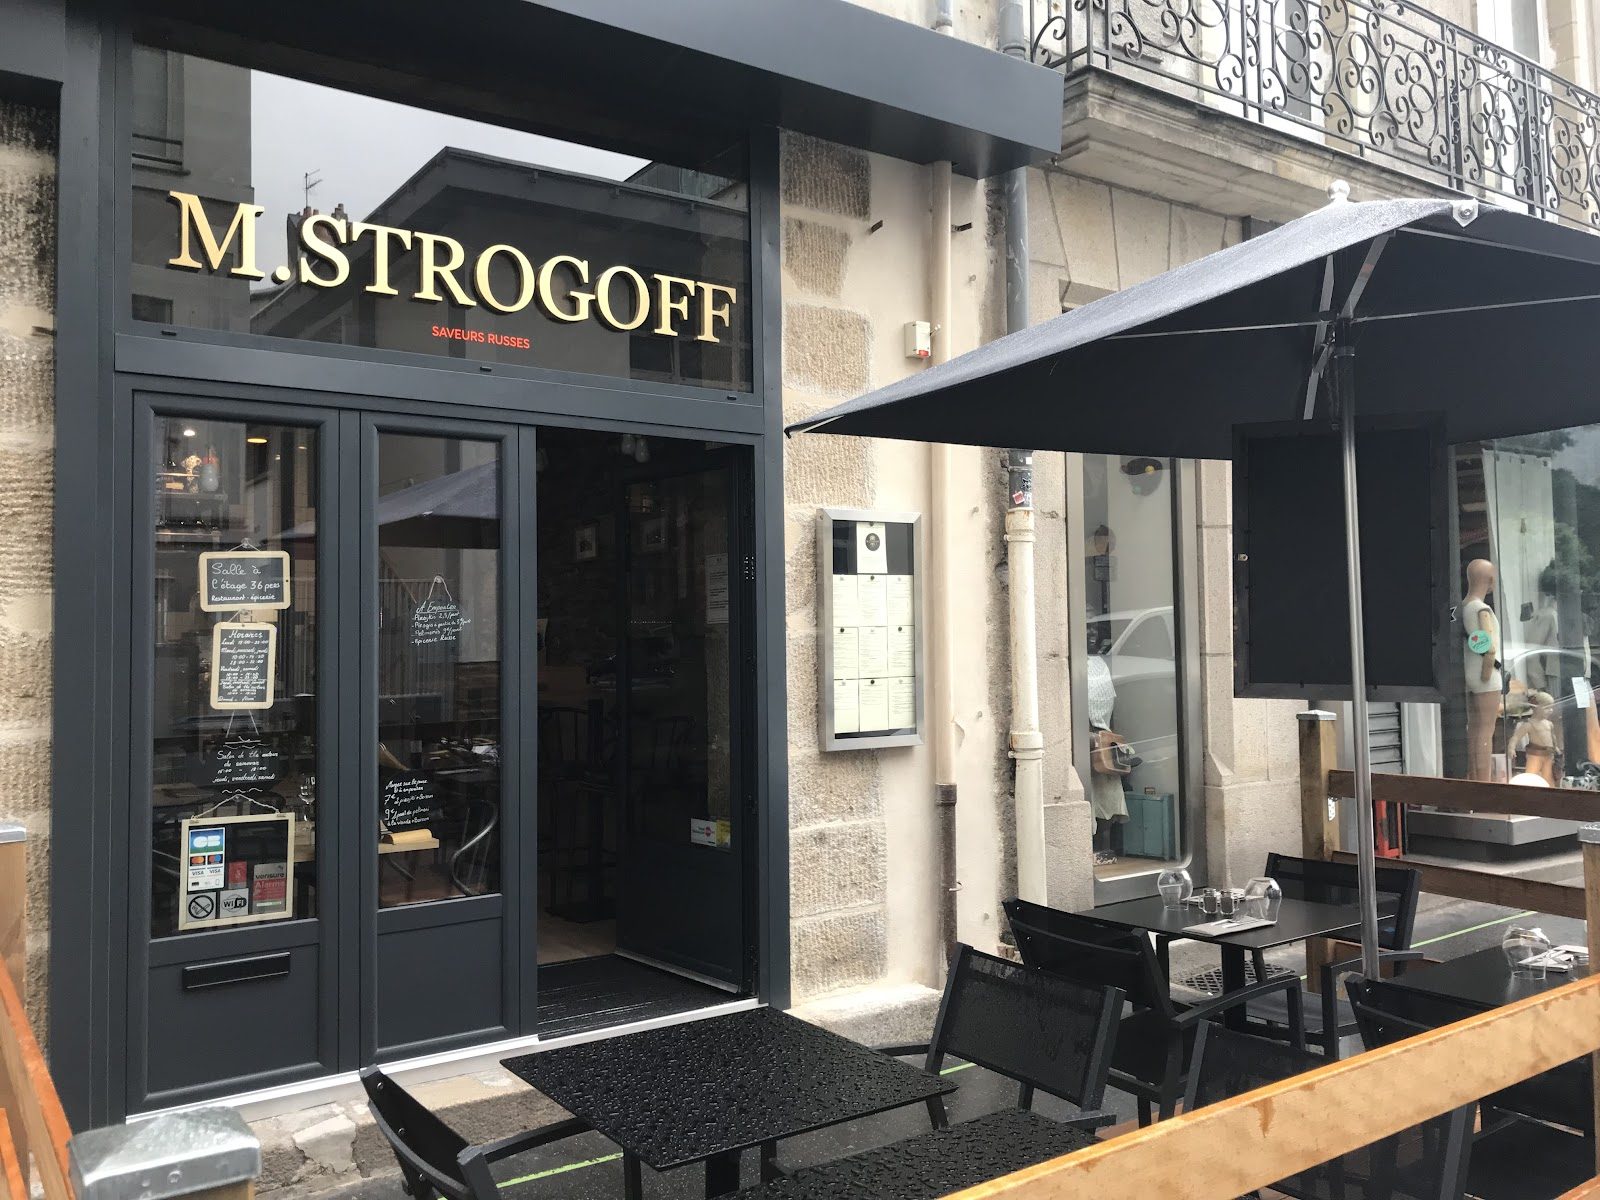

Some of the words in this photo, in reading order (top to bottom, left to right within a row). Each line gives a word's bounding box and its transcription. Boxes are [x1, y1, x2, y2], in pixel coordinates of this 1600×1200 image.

[431, 325, 486, 344] SAVEURS
[487, 333, 531, 350] RUSSES
[211, 562, 247, 575] Salle
[251, 564, 262, 575] à
[250, 580, 264, 590] 36
[255, 872, 285, 880] verisure
